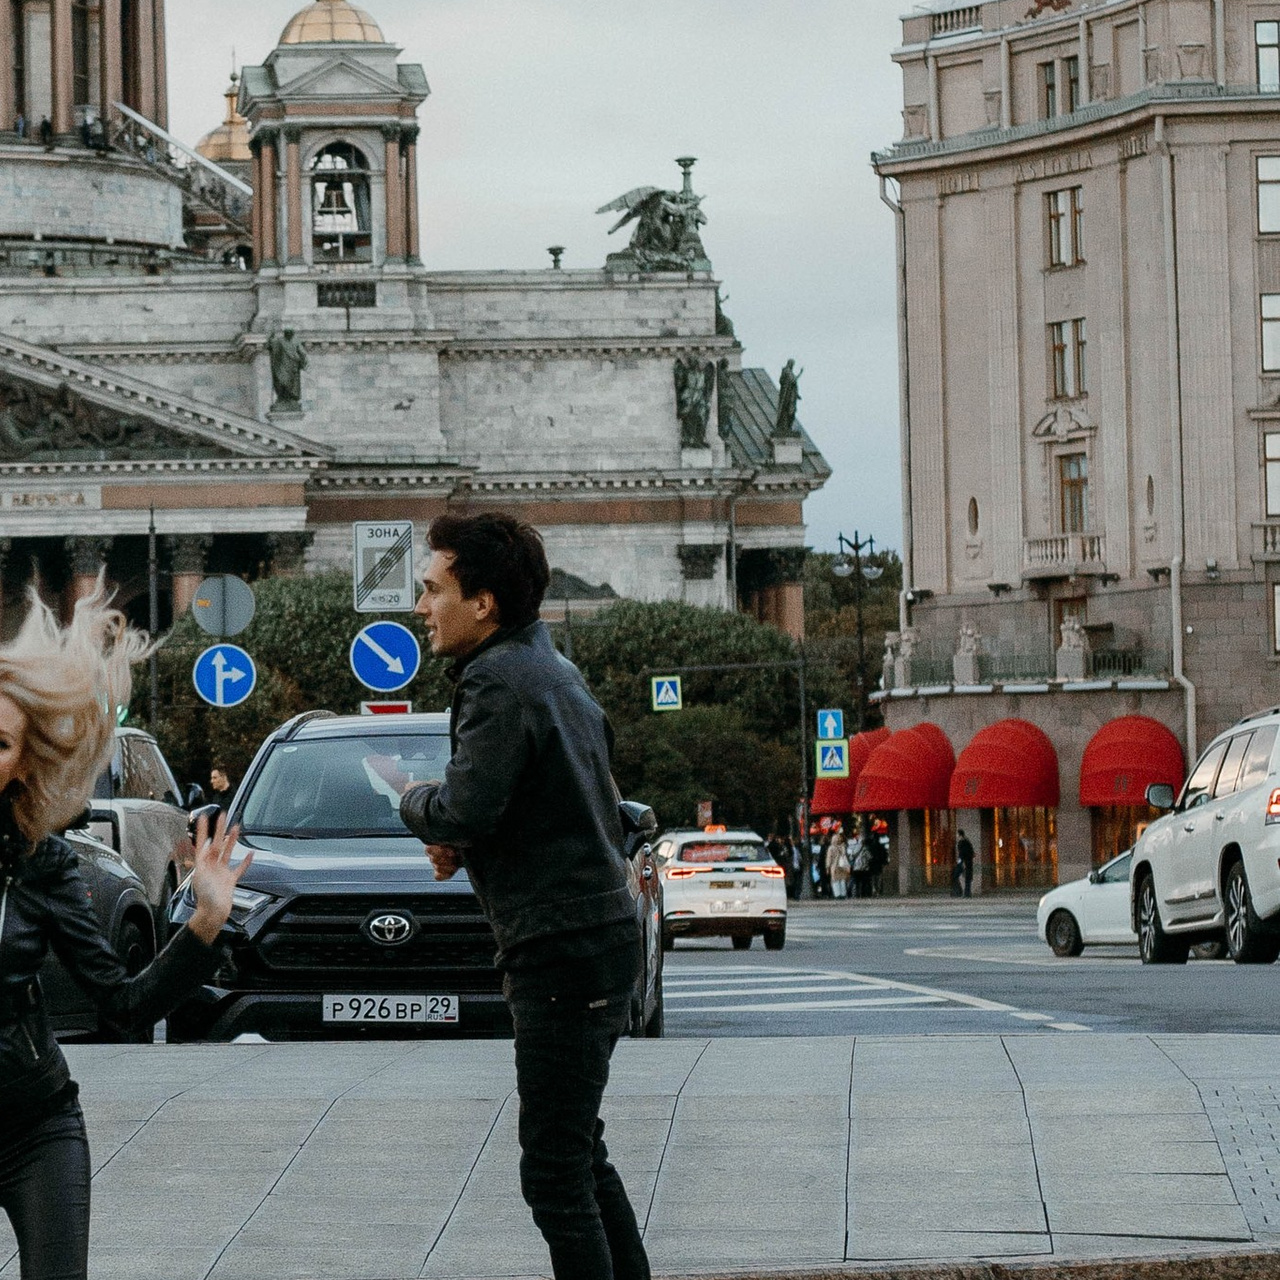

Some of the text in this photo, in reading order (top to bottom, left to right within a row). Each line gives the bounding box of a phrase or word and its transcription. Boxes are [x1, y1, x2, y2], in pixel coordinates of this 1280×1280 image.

[367, 528, 400, 539] ЗОНА
[332, 997, 451, 1019] Р926ВР 29
[427, 1013, 444, 1021] RUS
